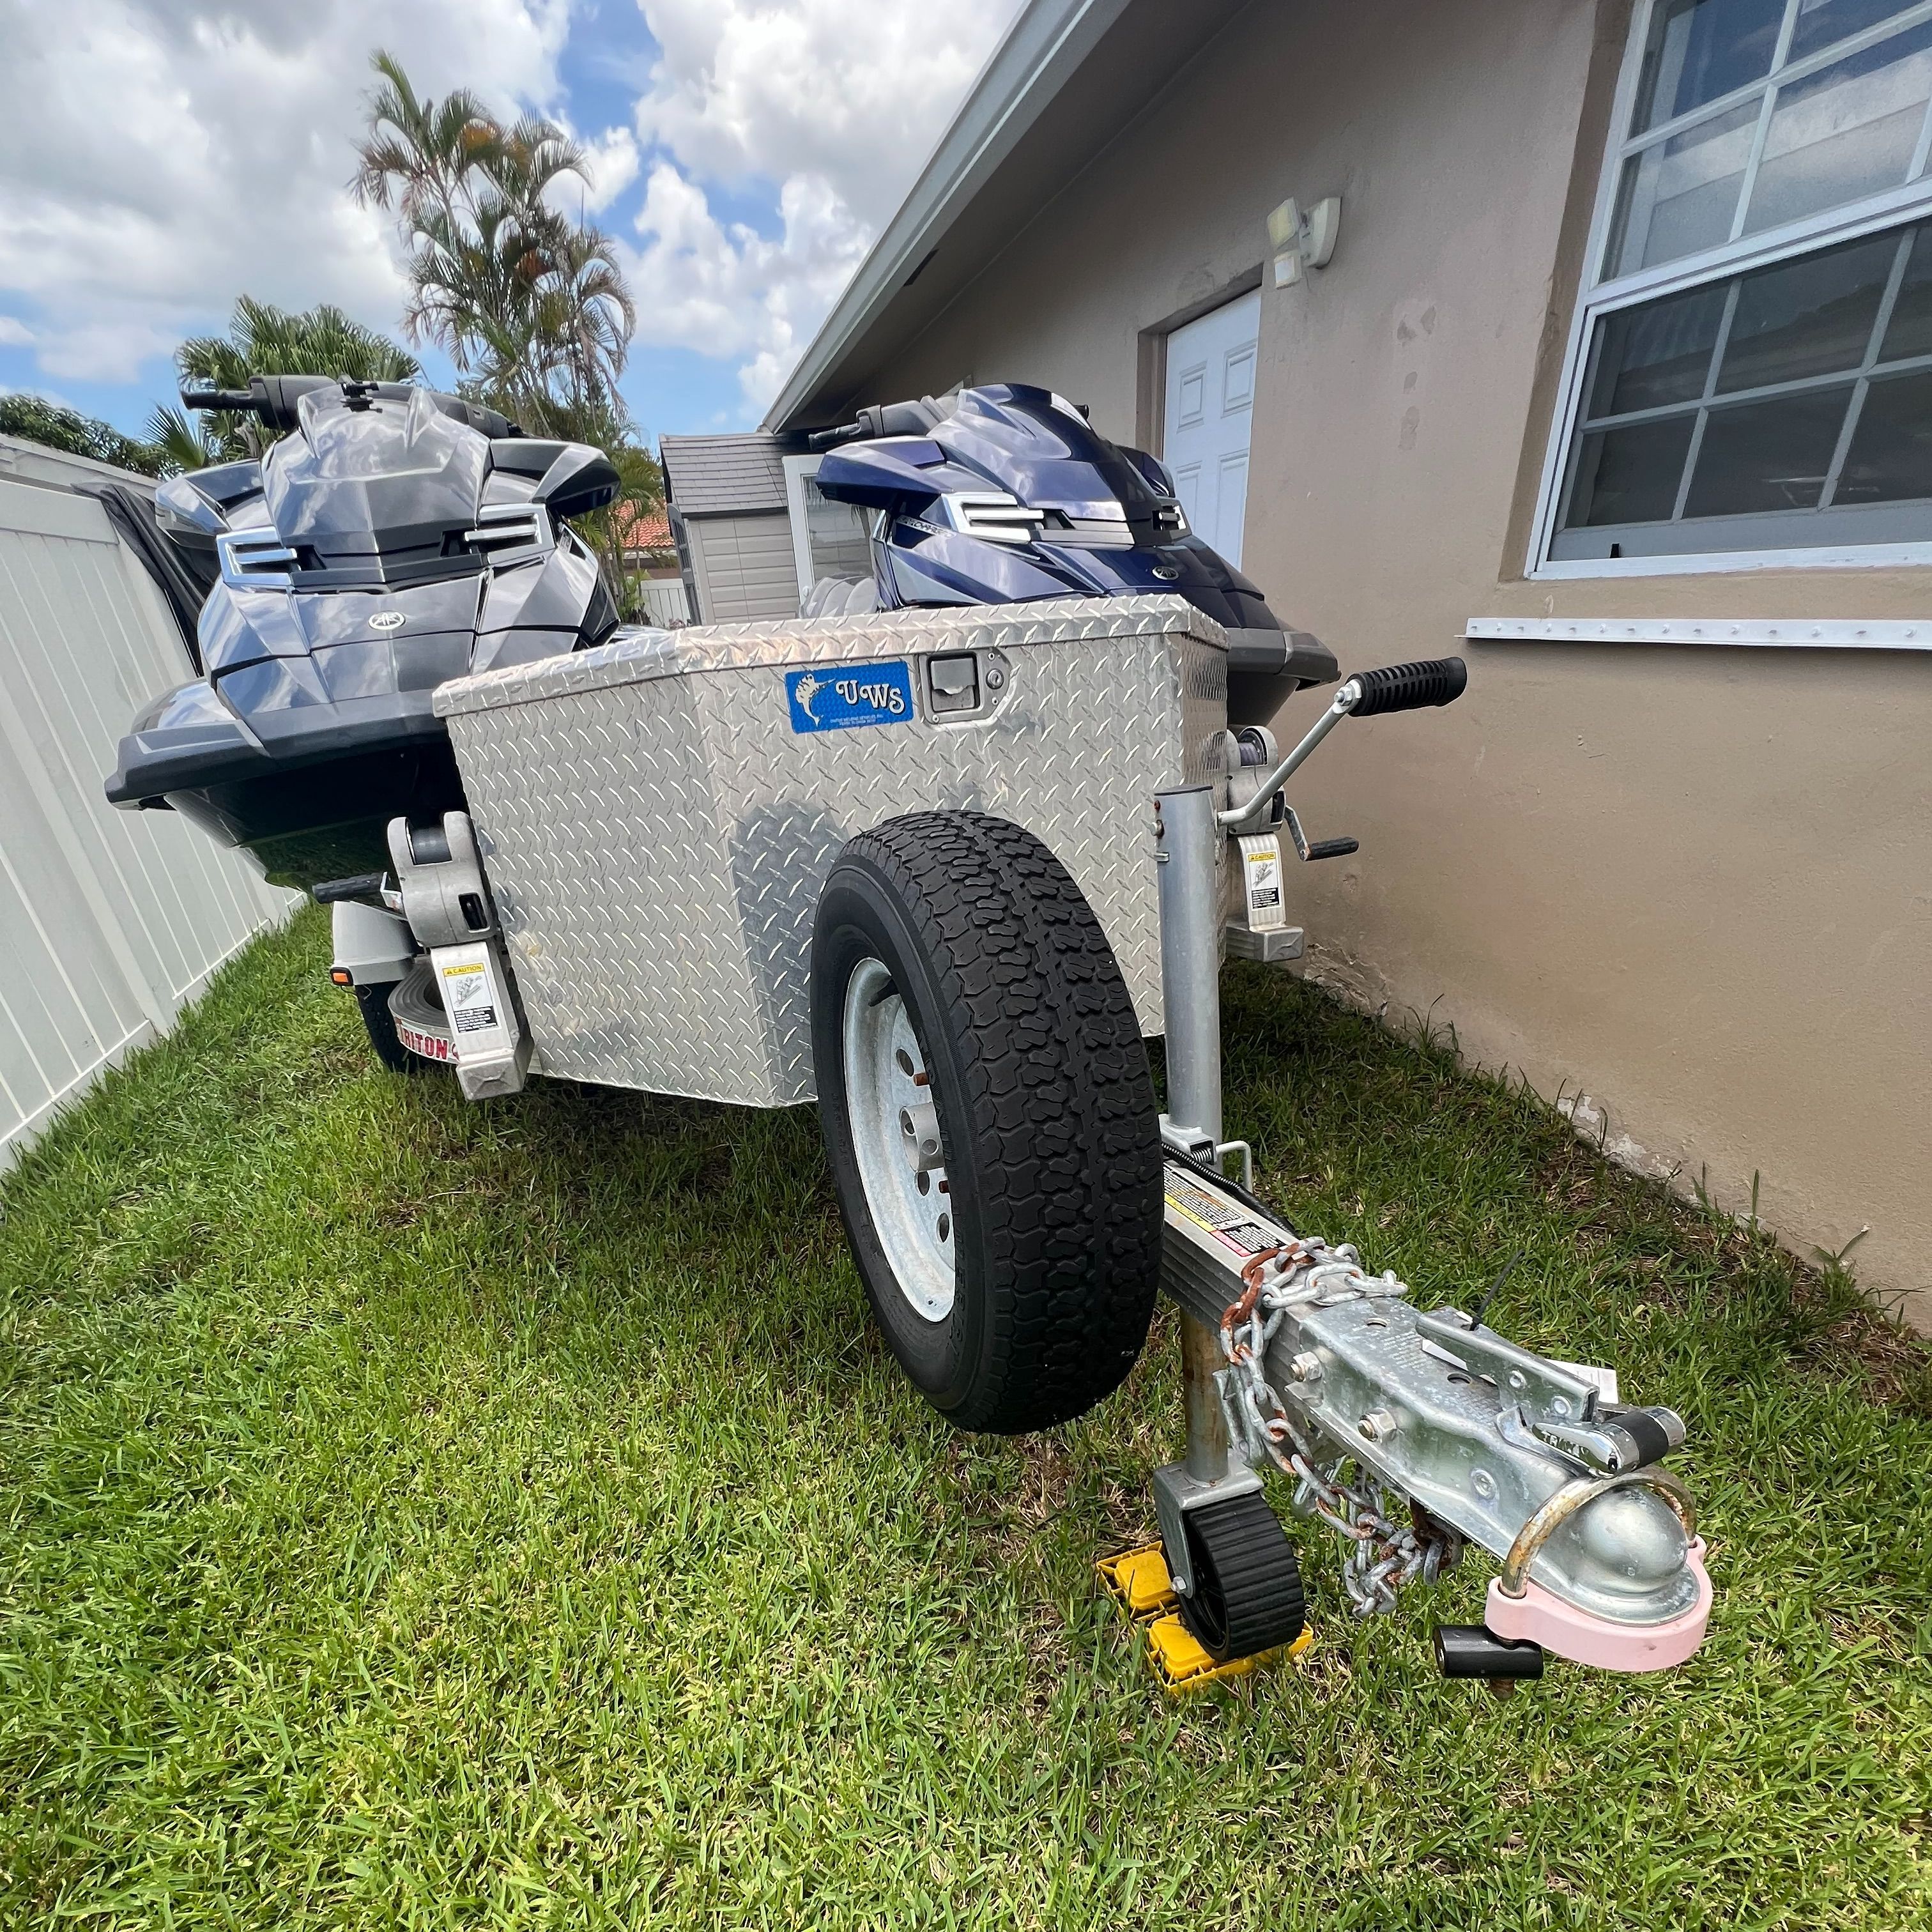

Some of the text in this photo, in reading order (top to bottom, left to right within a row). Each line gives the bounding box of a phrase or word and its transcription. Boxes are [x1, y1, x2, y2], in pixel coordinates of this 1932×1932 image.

[835, 680, 905, 714] UWS
[453, 965, 482, 974] CAUTION
[394, 1016, 448, 1060] TRITON
